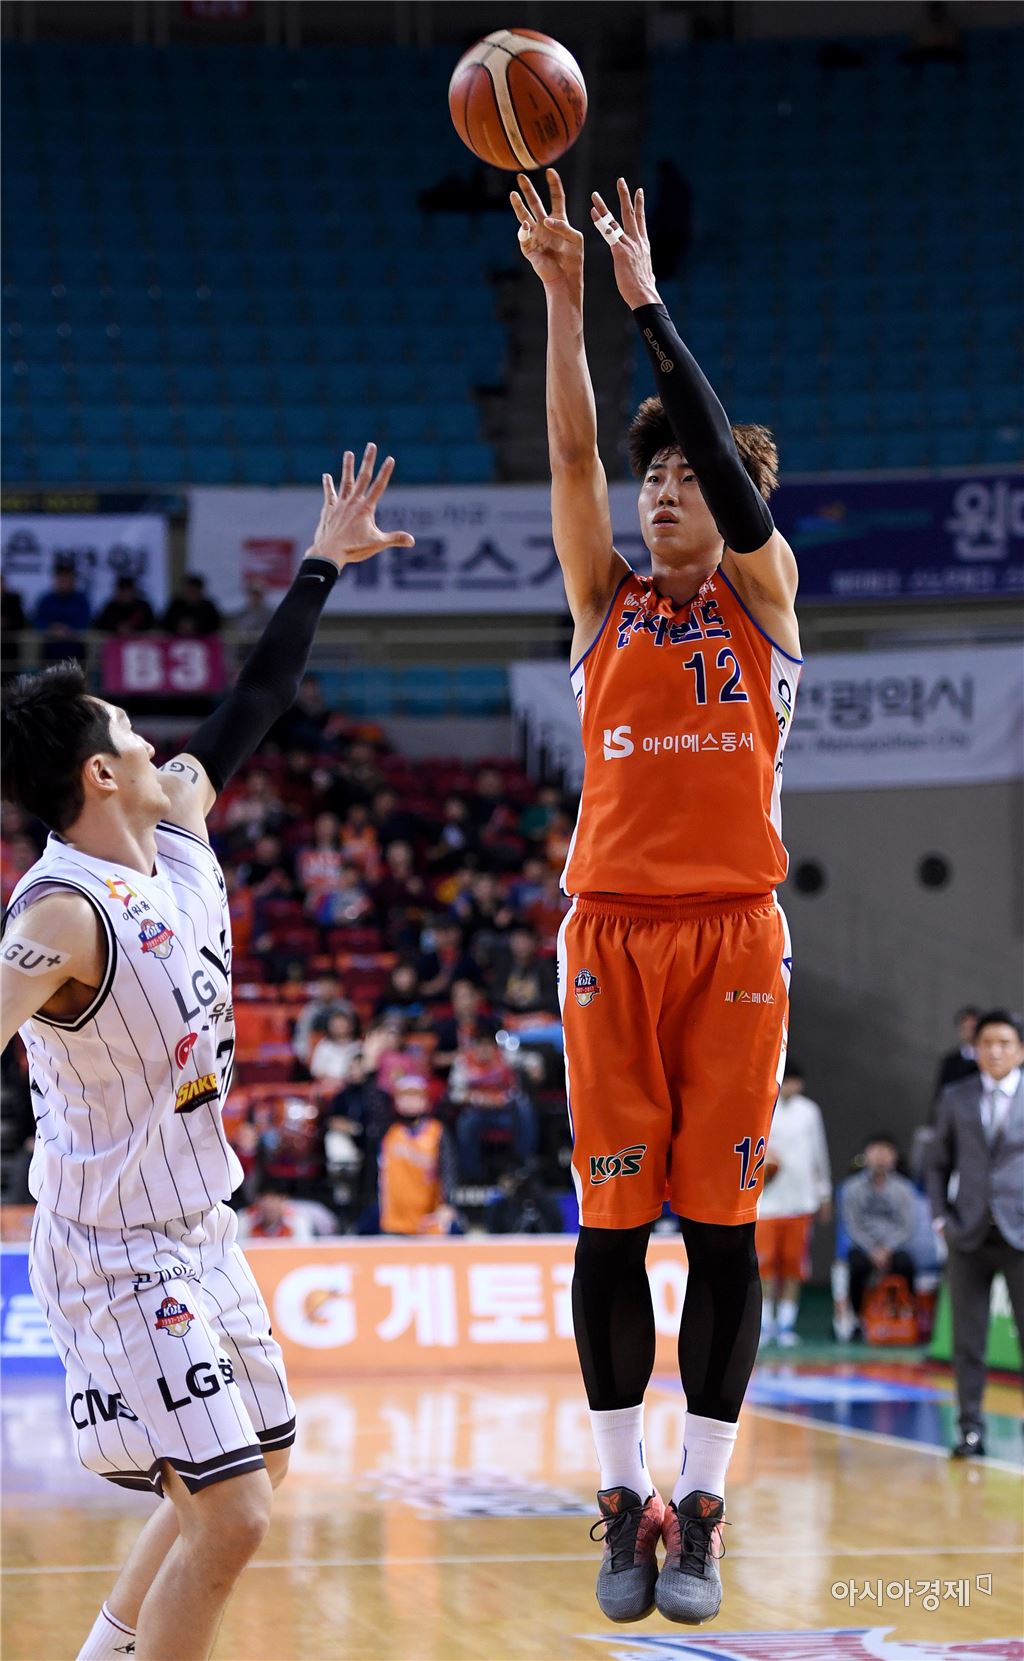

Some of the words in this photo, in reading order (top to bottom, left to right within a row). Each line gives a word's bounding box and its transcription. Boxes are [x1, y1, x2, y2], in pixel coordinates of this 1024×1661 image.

[683, 646, 749, 706] 12
[642, 732, 754, 755] 아이에스동서
[160, 760, 199, 785] LG
[1, 943, 62, 970] GU+
[172, 970, 217, 1023] LG
[176, 1072, 218, 1110] SAKE
[590, 1144, 648, 1186] KOS
[733, 1136, 766, 1191] 12
[157, 1360, 221, 1412] LG
